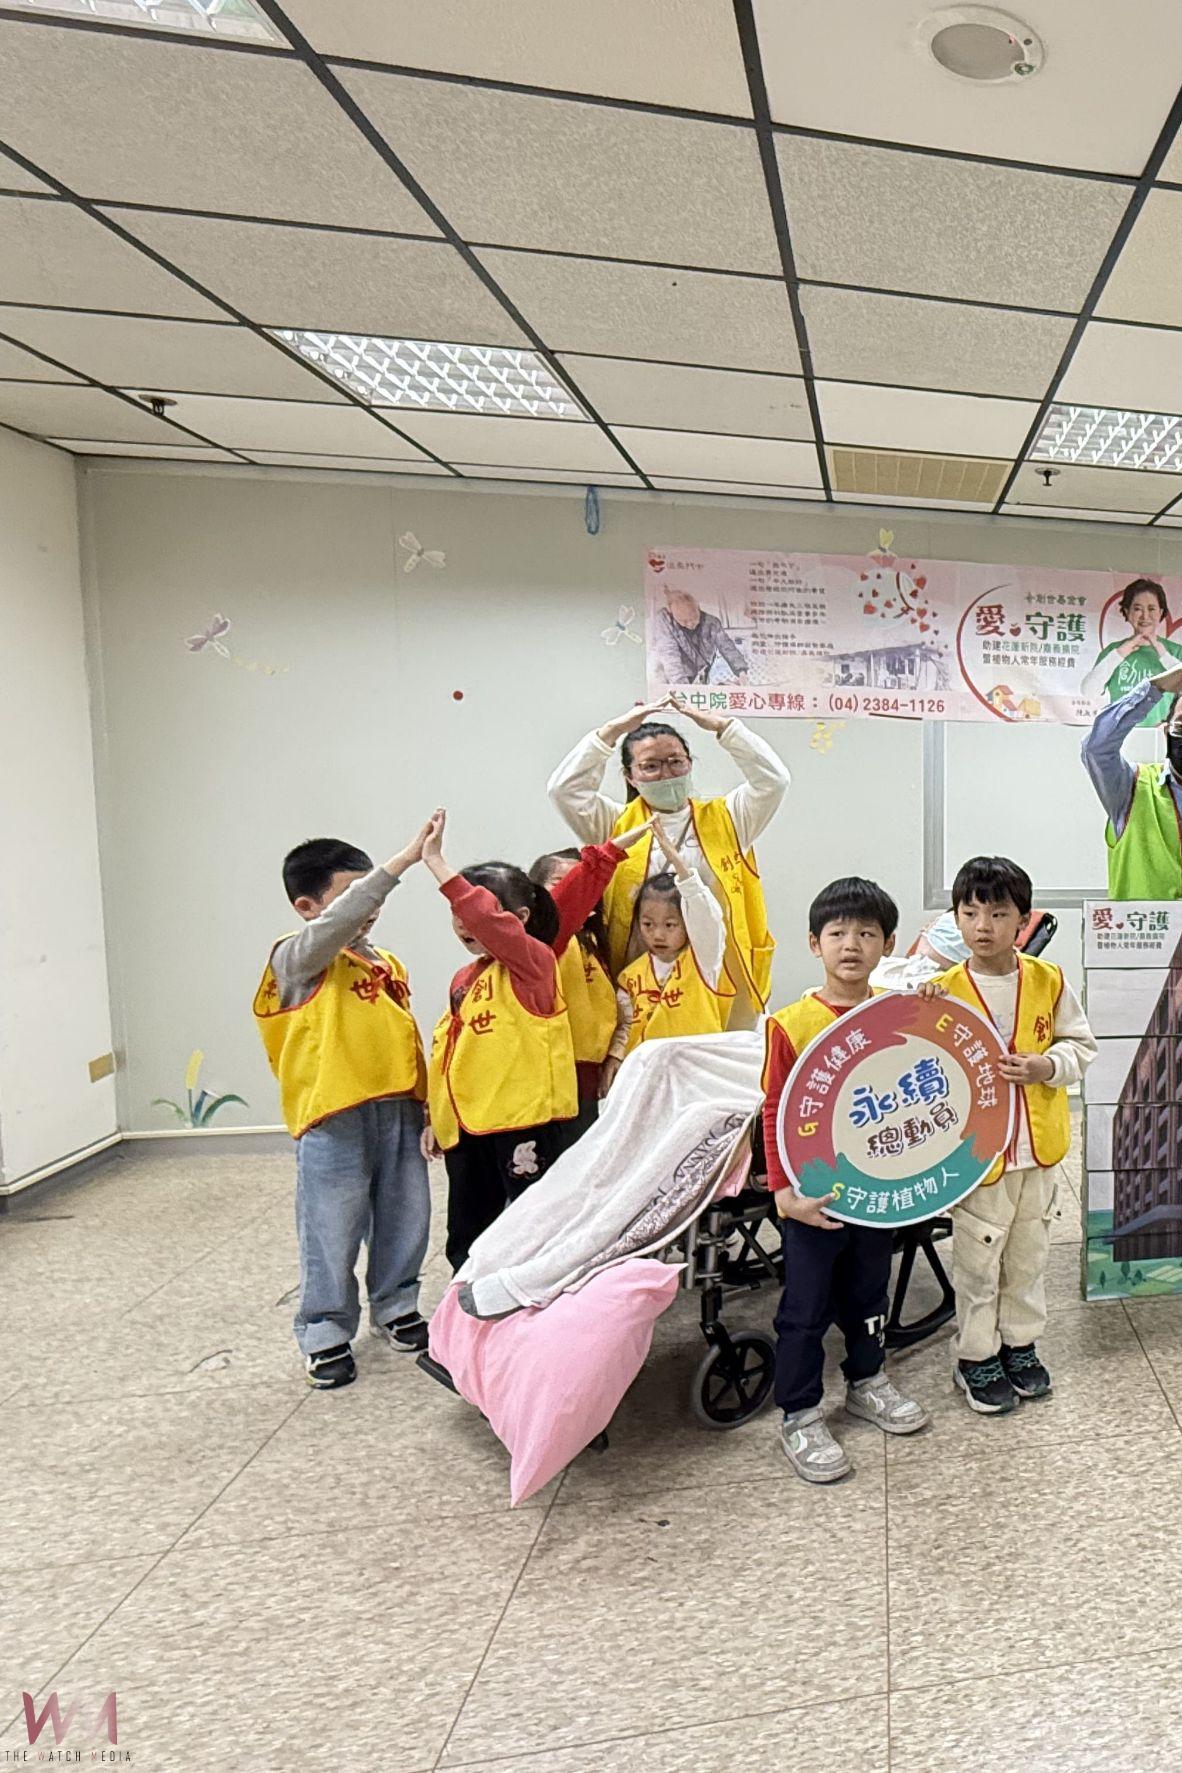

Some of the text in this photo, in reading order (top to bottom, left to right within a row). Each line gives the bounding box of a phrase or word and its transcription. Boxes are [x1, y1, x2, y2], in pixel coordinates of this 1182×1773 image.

[799, 1028, 872, 1118] 守護健康
[849, 1056, 949, 1127] 永續
[953, 1023, 998, 1109] 守護地球
[867, 1102, 959, 1158] 總動員
[847, 1166, 960, 1214] 守護植物人
